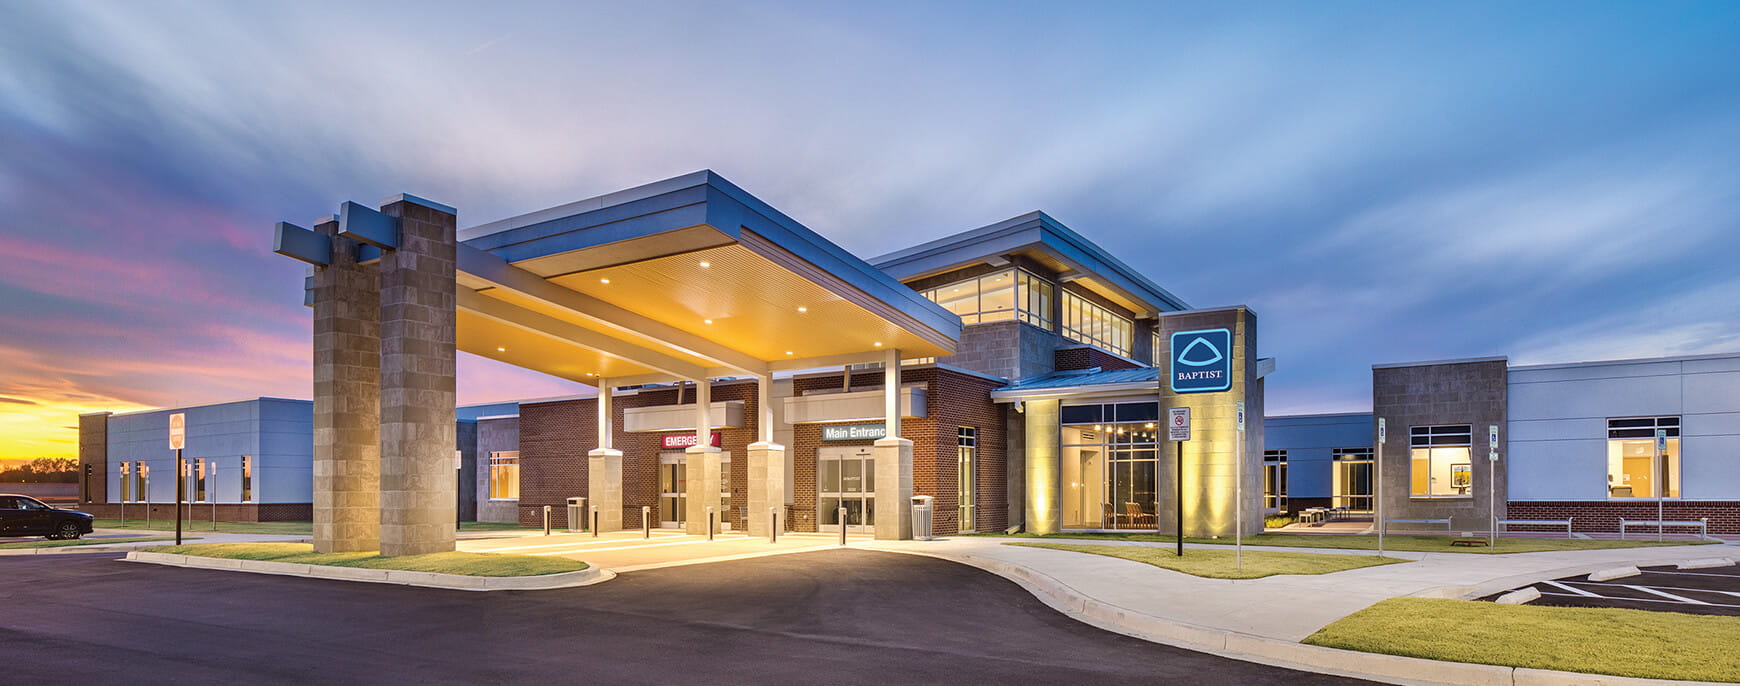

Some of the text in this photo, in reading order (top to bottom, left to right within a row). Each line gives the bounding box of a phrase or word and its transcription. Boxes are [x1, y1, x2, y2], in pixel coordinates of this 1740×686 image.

[1178, 370, 1222, 380] BAPTIST
[826, 427, 886, 438] Main Entranc
[665, 435, 714, 446] EMERGEY
